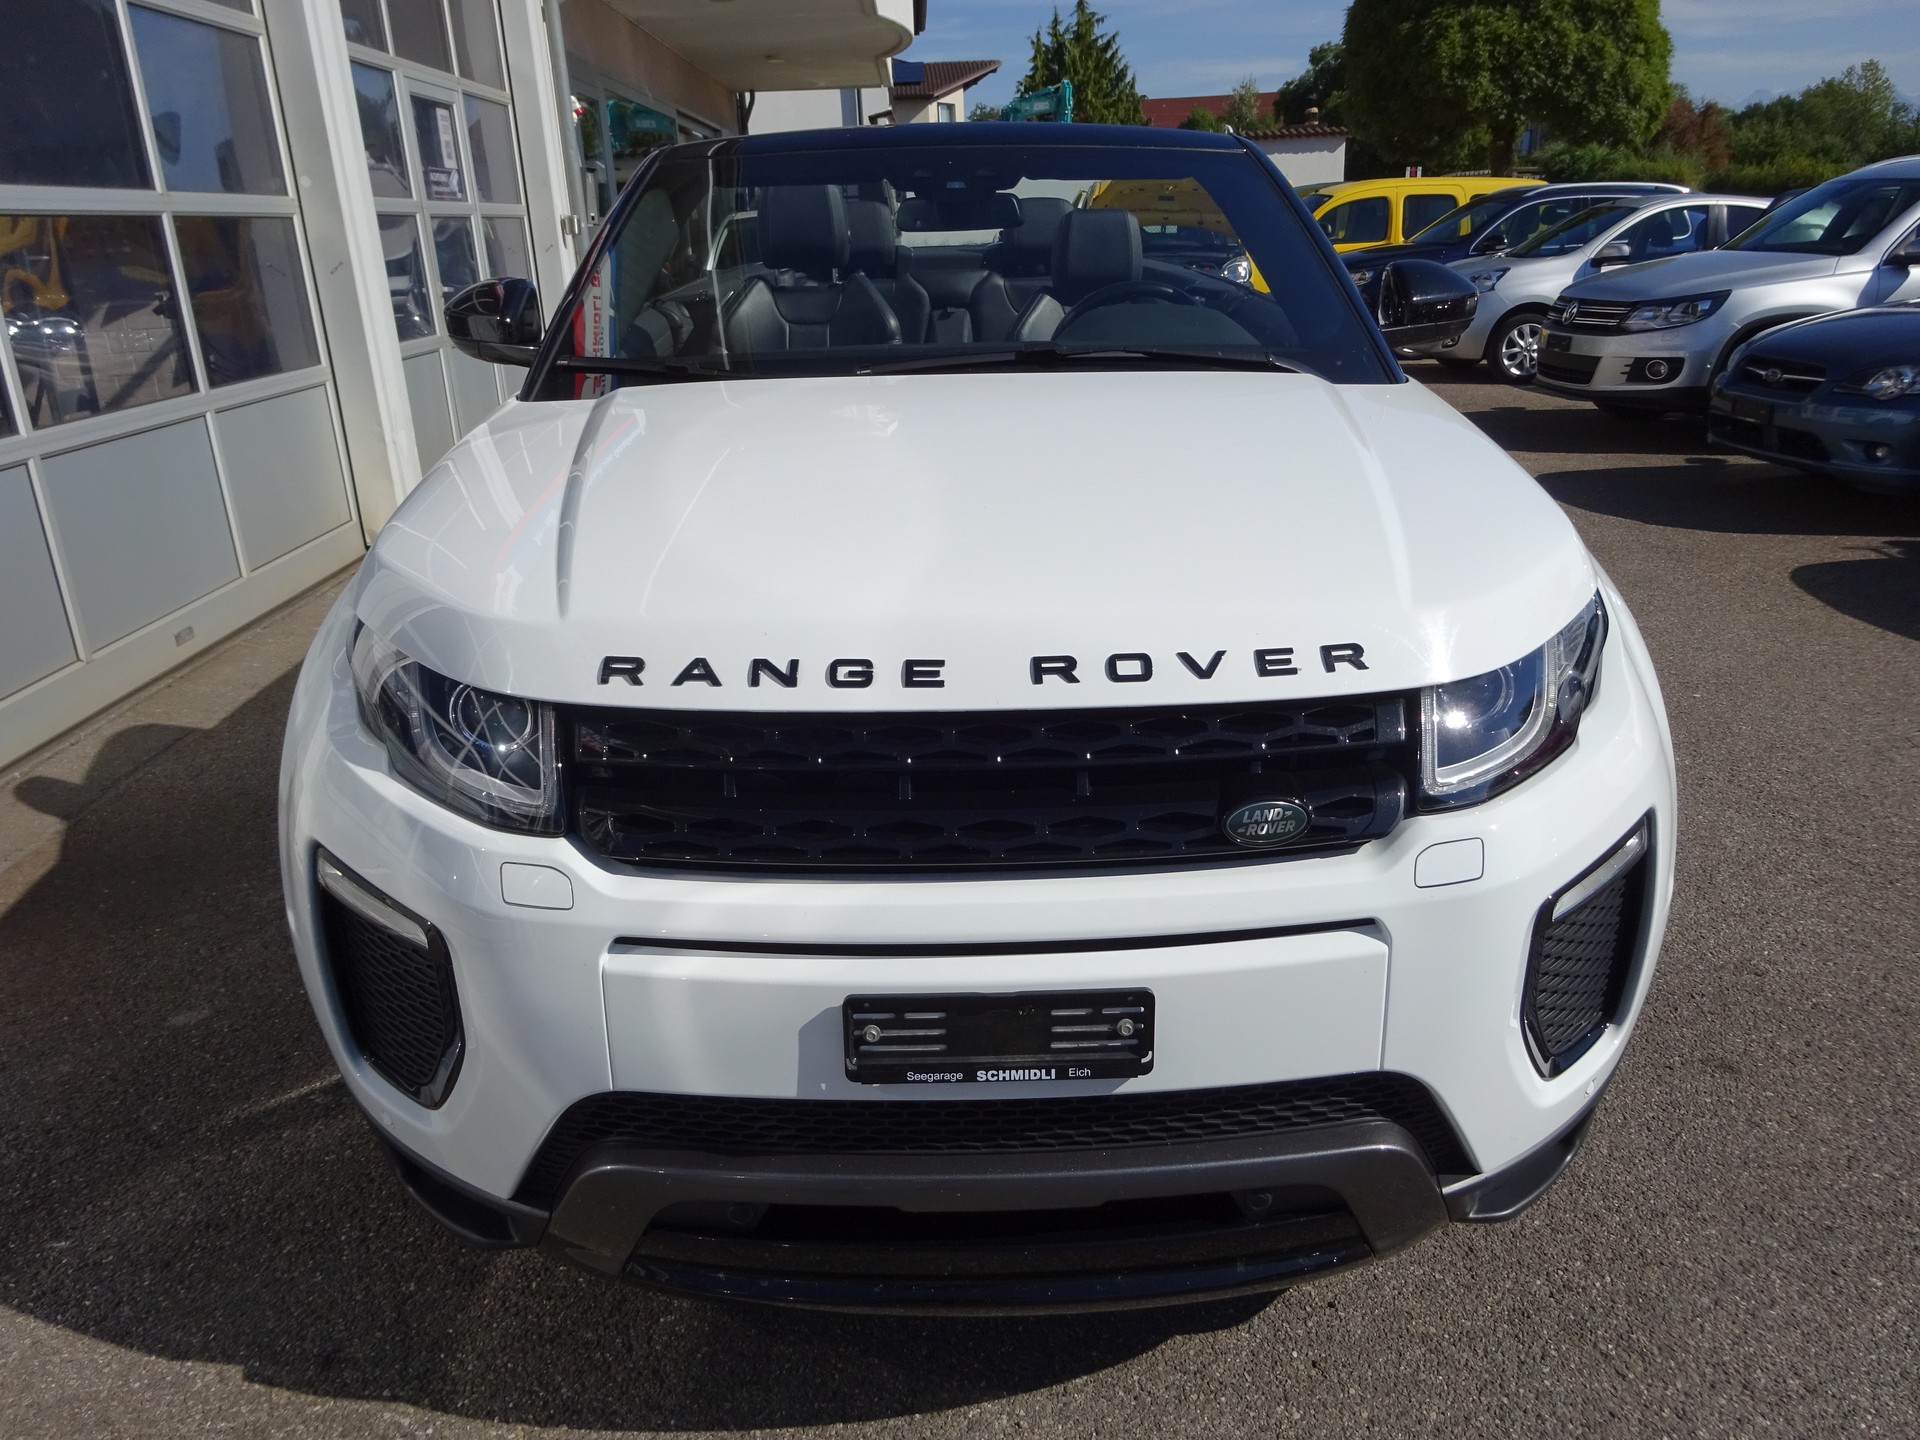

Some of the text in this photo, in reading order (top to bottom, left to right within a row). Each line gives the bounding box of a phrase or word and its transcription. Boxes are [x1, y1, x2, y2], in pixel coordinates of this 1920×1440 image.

[597, 642, 1370, 689] RANGE ROVER
[1242, 807, 1284, 823] LAND
[1246, 820, 1296, 836] ROVER
[906, 1067, 1091, 1083] Seegarage SCHMIDLI Eich
